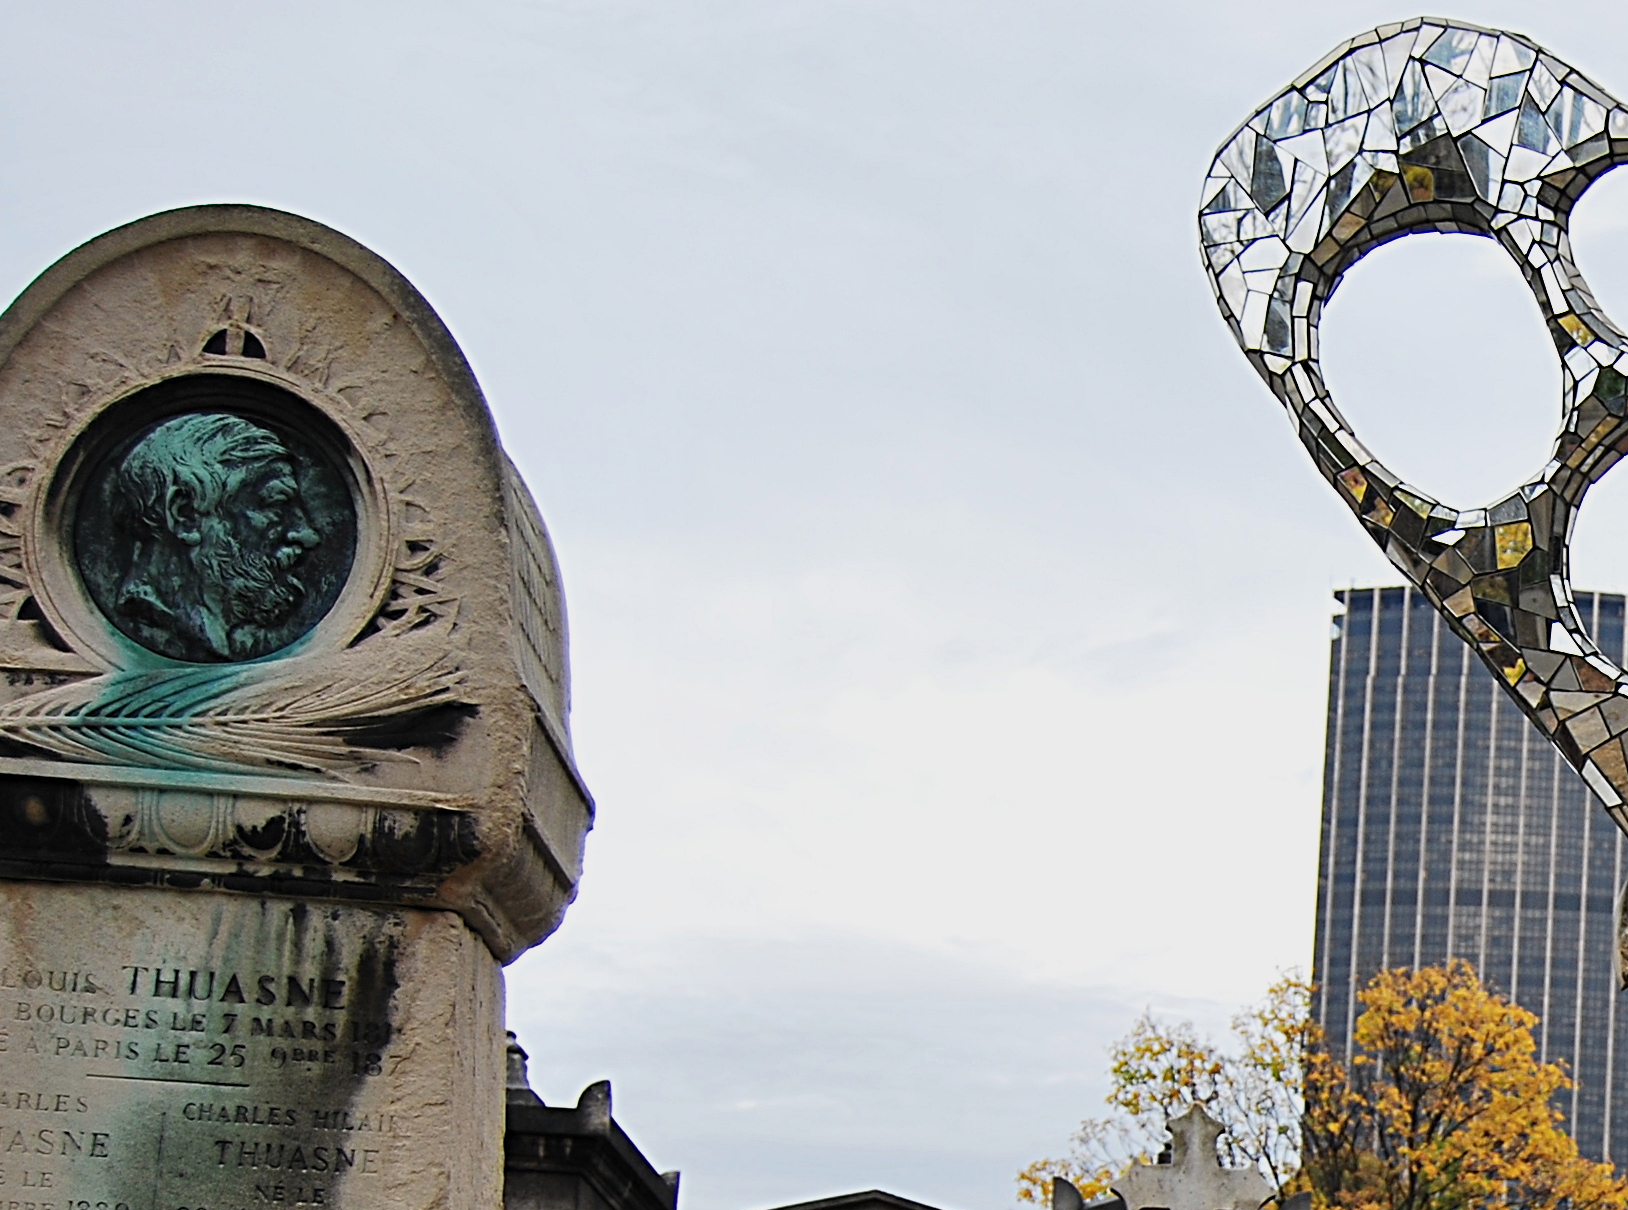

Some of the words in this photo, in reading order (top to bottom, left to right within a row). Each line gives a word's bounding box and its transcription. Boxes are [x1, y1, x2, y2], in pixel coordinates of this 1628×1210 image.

[1, 967, 98, 994] LOUIS
[122, 965, 346, 1010] THUASNE
[15, 1002, 159, 1030] BOURGES
[171, 1012, 206, 1032] LE
[223, 1013, 238, 1034] 7
[251, 1017, 337, 1042] MARS
[54, 1036, 140, 1061] PARIS
[153, 1043, 191, 1064] LE
[207, 1042, 246, 1068] 25
[182, 1102, 297, 1126] CHARLES
[214, 1140, 380, 1174] THUASNE
[297, 1187, 326, 1204] LE
